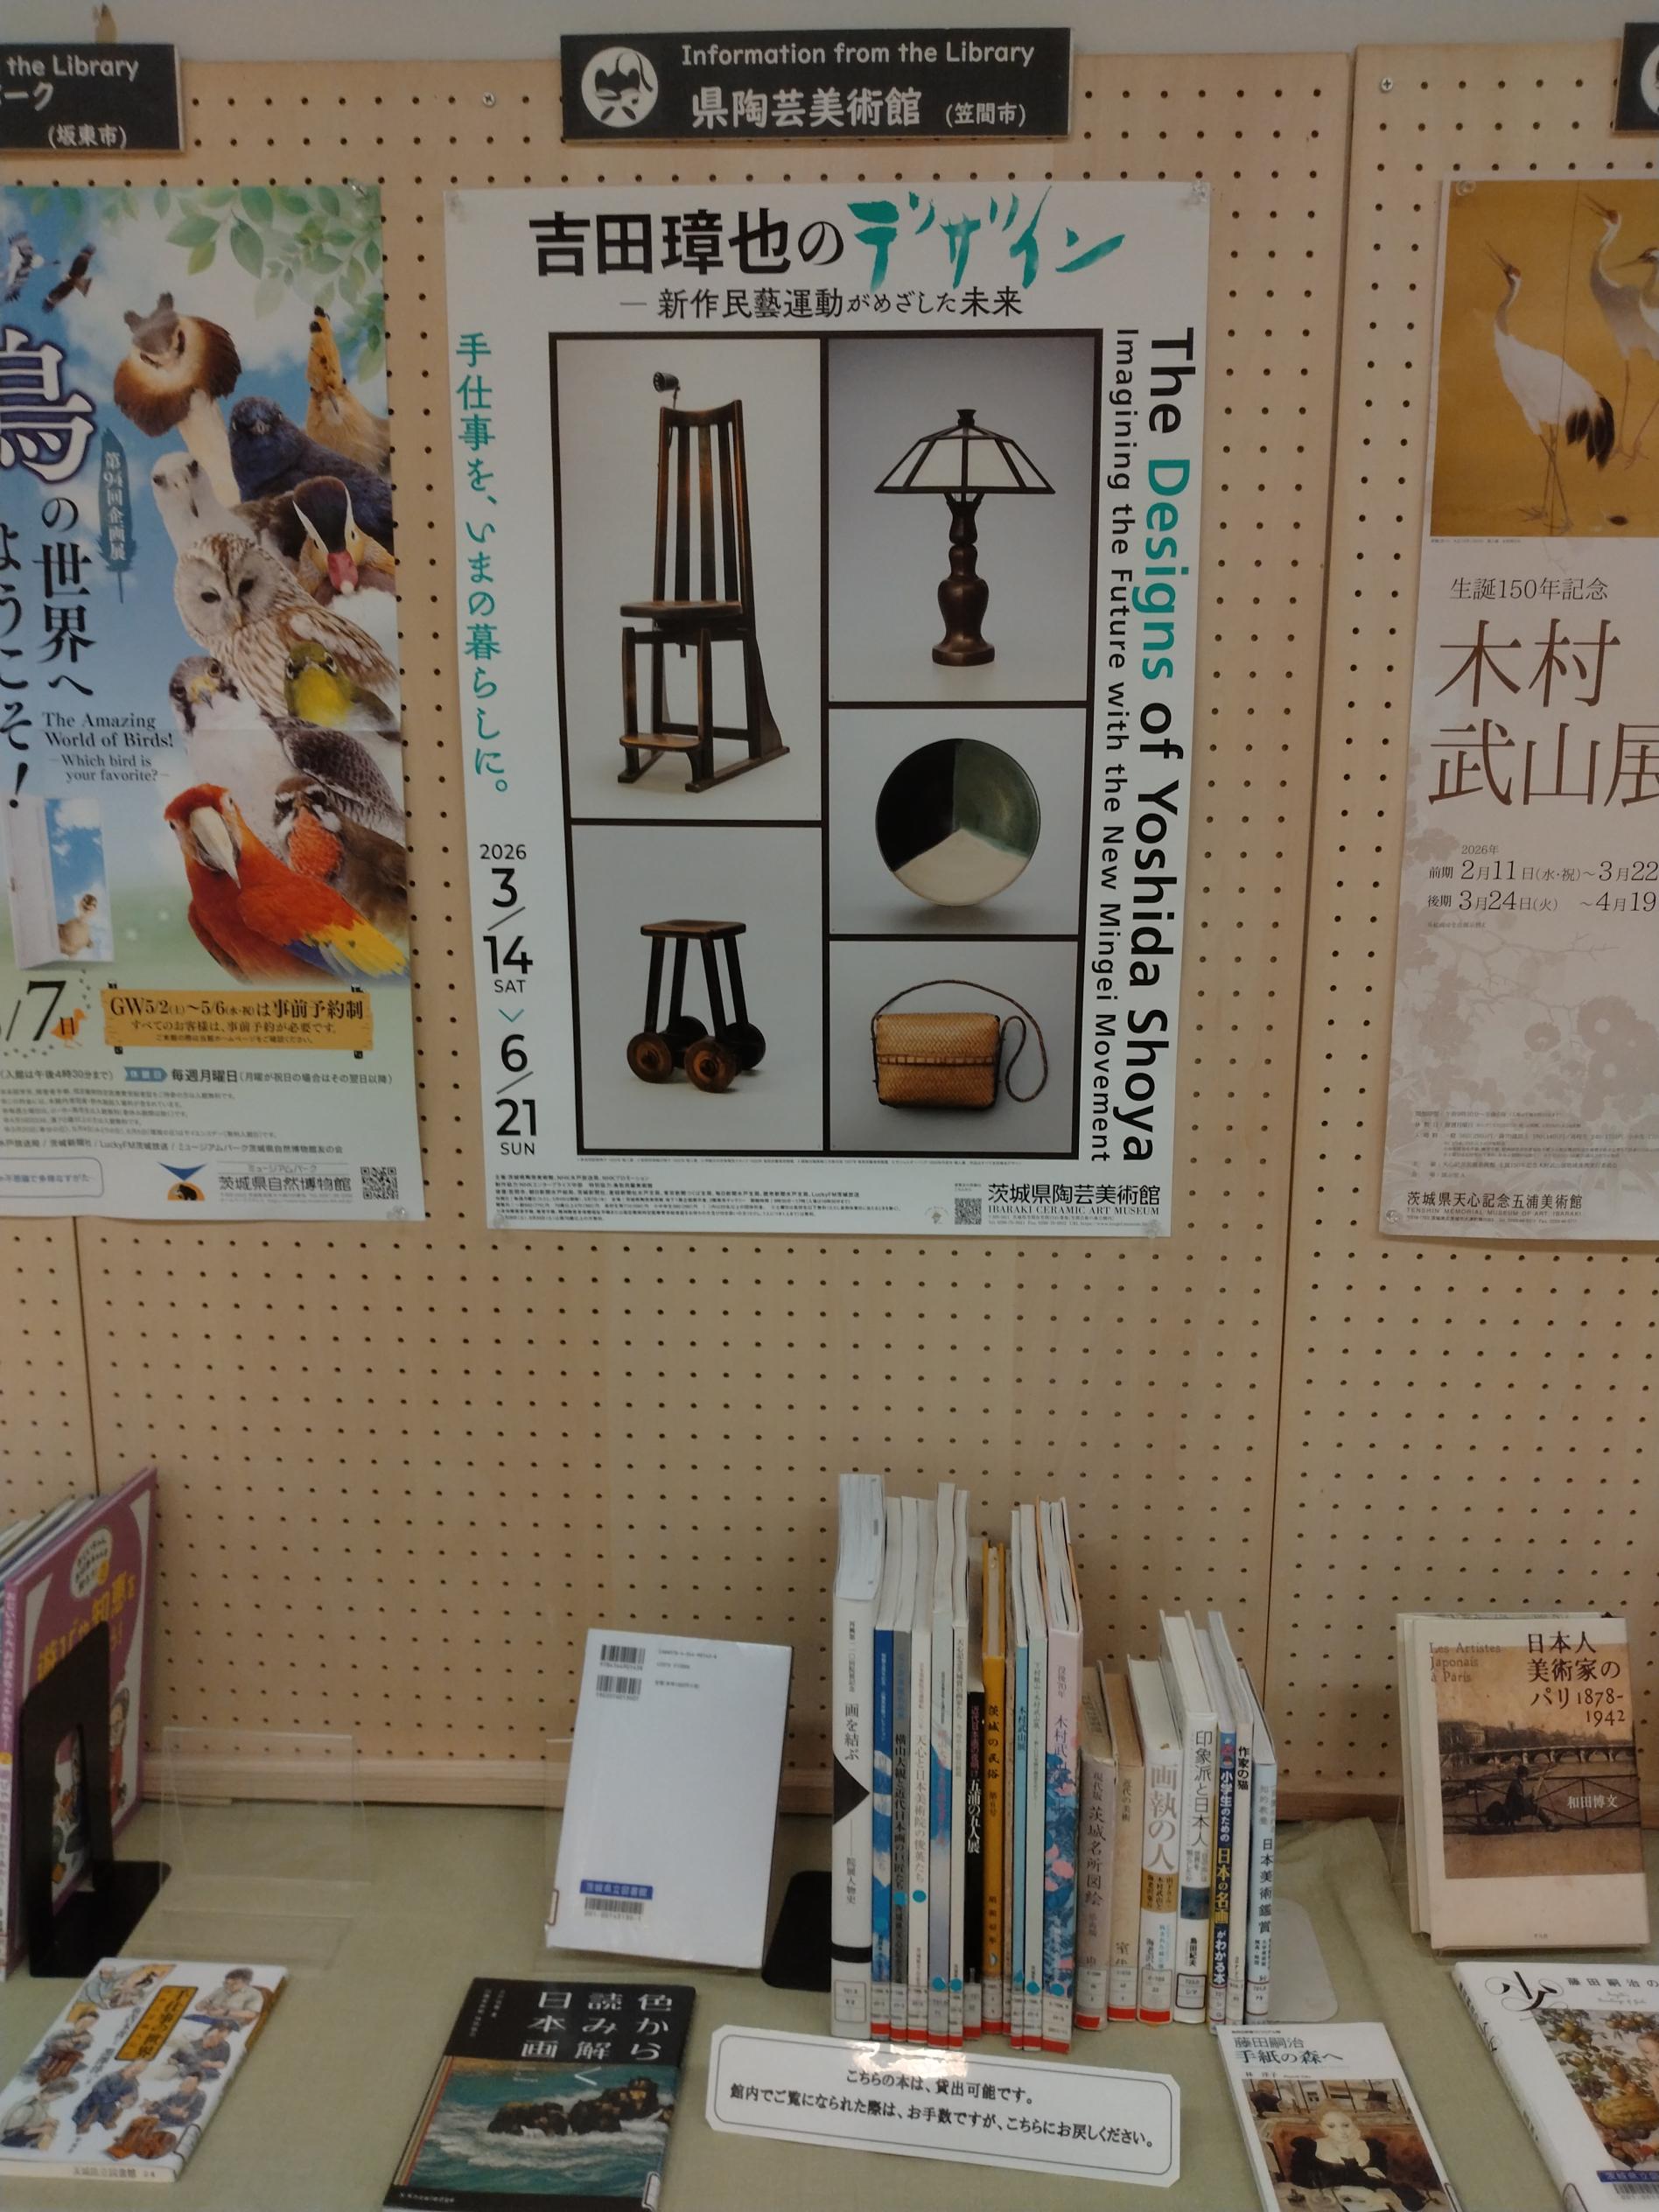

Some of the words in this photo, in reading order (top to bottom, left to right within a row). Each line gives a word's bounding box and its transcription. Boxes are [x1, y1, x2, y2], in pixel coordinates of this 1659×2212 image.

[7, 55, 46, 76] the
[52, 53, 139, 82] Library
[682, 44, 826, 66] Information
[834, 42, 891, 64] from
[898, 41, 938, 63] the
[946, 40, 1035, 66] Library
[0, 81, 54, 112] ーク
[691, 86, 923, 130] 県陶芸美術館
[945, 101, 1026, 126] (笠間市)
[48, 122, 127, 150] (坂東市)
[1149, 327, 1196, 434] The
[1108, 329, 1139, 490] Imagining
[1112, 503, 1136, 555] the
[456, 332, 508, 793] 手仕事を、いまの暮らしに。
[1131, 458, 1191, 680] Designs
[1449, 578, 1609, 601] 生誕150年記念
[1108, 569, 1133, 669] Future
[1434, 618, 1621, 708] 木村
[42, 711, 76, 729] The
[82, 712, 157, 731] Amazing
[1106, 682, 1130, 751] with
[1139, 703, 1184, 760] of
[44, 732, 96, 748] World
[102, 732, 119, 748] of
[124, 732, 174, 749] Birds!
[109, 754, 137, 768] bird
[140, 754, 152, 768] is
[66, 771, 94, 783] your
[1104, 765, 1129, 812] the
[480, 843, 528, 860] 2026
[1101, 827, 1124, 891] New
[1429, 865, 1454, 879] 前期
[1461, 844, 1500, 855] 2026年
[1129, 780, 1180, 987] Yoshida
[1427, 894, 1452, 907] 後期
[1092, 903, 1122, 1001] Mingei
[494, 979, 527, 993] SAT
[1090, 1014, 1116, 1162] Movement
[1113, 1009, 1170, 1161] Shoya
[500, 1142, 536, 1156] SUN
[218, 1175, 352, 1193] 茨城県自然博物館
[987, 1182, 1161, 1206] 茨城県陶芸美術館
[1406, 1190, 1583, 1210] 茨城県天心記念五浦美術館
[988, 1205, 1032, 1214] IBARAKI
[1036, 1206, 1086, 1214] CERAMIC
[1088, 1206, 1111, 1215] ART
[1114, 1207, 1160, 1216] MUSEUM
[1429, 1642, 1452, 1655] Les
[1456, 1642, 1502, 1655] Artistes
[1430, 1656, 1480, 1671] Japonais
[1527, 1630, 1598, 1655] 日本人
[1442, 1670, 1473, 1684] Paris
[1526, 1657, 1620, 1684] 美術家の
[844, 1702, 860, 1761] 画を結ぶ
[1586, 1708, 1627, 1727] 1942
[987, 1704, 999, 1779] 茨城の民俗
[1191, 1729, 1213, 1848] 印象派と日本人
[1237, 1744, 1250, 1792] 作家の猫
[966, 1778, 981, 1854] 五浦の五人展
[1148, 1763, 1178, 1872] 画執の人
[1220, 1770, 1233, 1843] 小学生のための
[1566, 1795, 1619, 1810] 和田博文
[1084, 1805, 1107, 1907] 茨城名所図絵
[1214, 1847, 1232, 1925] 日本の名画
[1258, 1838, 1275, 1934] 日本美術鑑賞
[1213, 1928, 1228, 1984] がわかる本
[521, 1991, 573, 2060] 日本画
[573, 1991, 623, 2086] 読み解く
[628, 1992, 673, 2062] 色から
[1233, 2036, 1305, 2049] 藤田嗣治
[1235, 2049, 1344, 2065] 手紙の森へ
[845, 2068, 1033, 2105] こちらの本は、貸出可能です。
[729, 2082, 1155, 2148] 館内でご覧になられた際は、お手数ですが、こちらにお戻しください。
